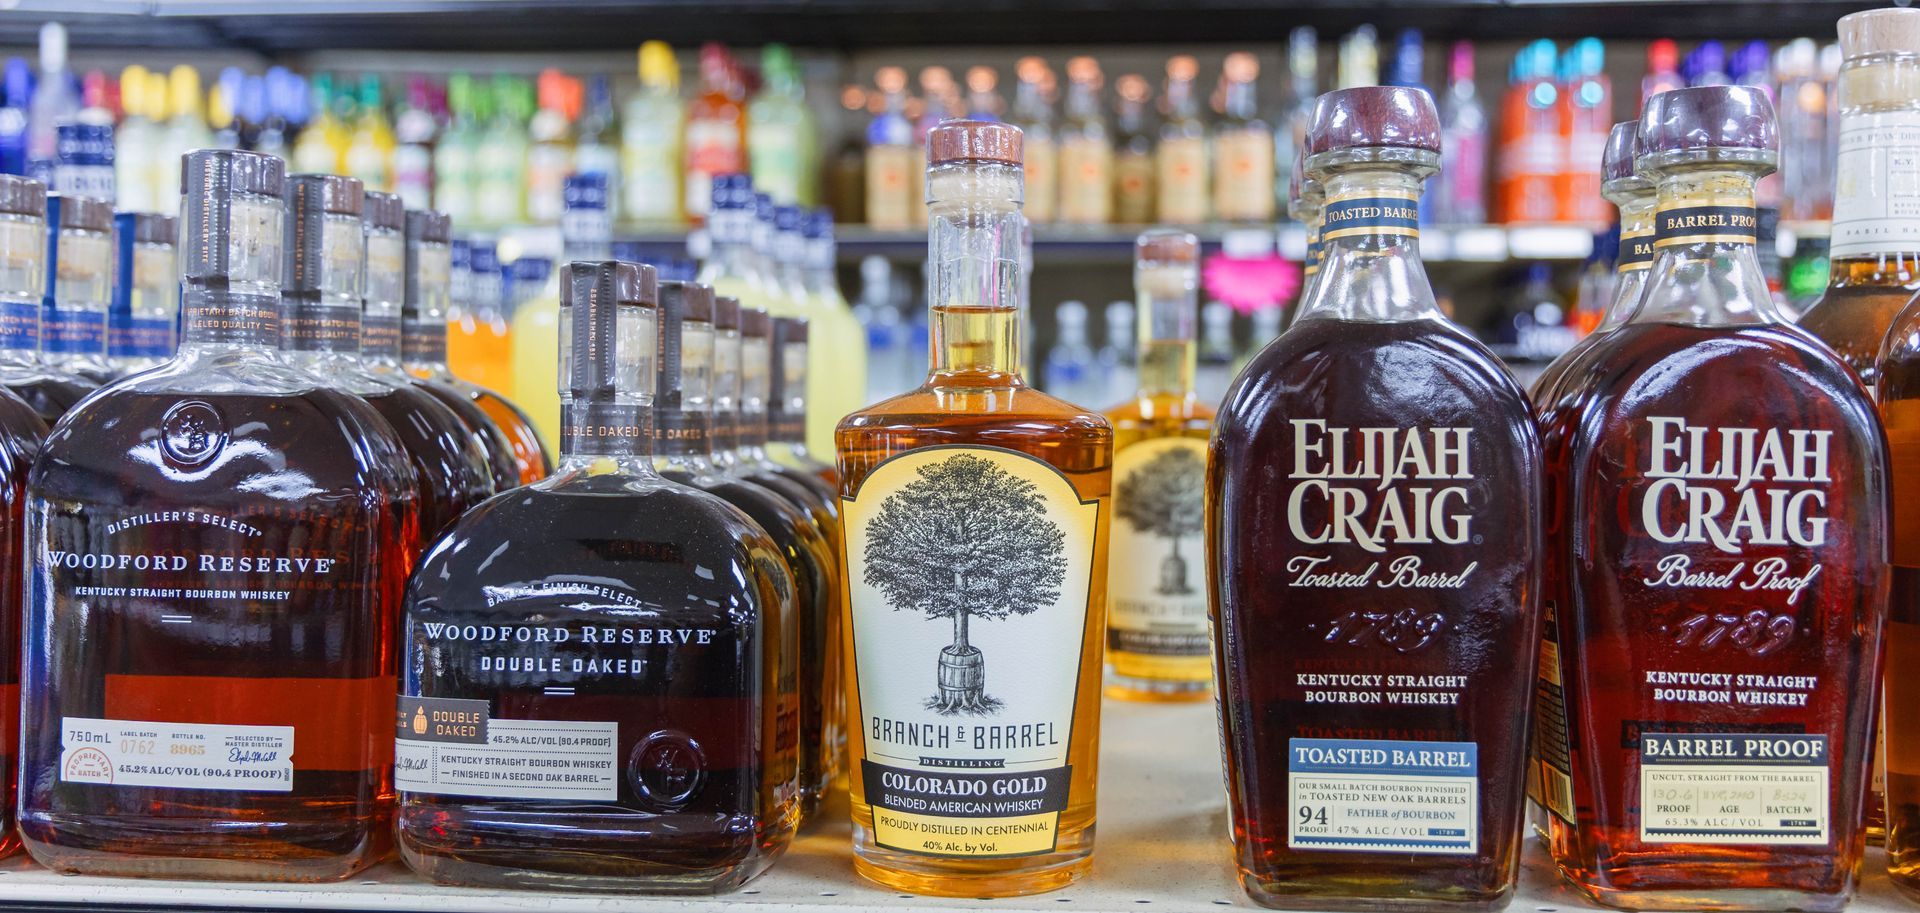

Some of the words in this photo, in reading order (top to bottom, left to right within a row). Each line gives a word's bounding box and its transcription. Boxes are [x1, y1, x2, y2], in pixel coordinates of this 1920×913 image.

[1329, 207, 1380, 223] TOASTED
[1667, 215, 1727, 230] BARREL
[222, 320, 261, 330] QUALITY
[599, 426, 639, 437] OAKED
[1288, 418, 1475, 492] ELIJAH
[1644, 416, 1834, 493] ELIJAH
[1287, 479, 1473, 553] CRAIG
[1642, 477, 1828, 553] CRAIG
[202, 513, 257, 537] SELECT
[47, 550, 188, 571] WOODFORD
[199, 554, 331, 574] RESERVE
[1286, 555, 1379, 588] Toasted
[1376, 555, 1478, 589] Barrel
[1643, 554, 1745, 589] Barrel
[1740, 557, 1822, 605] Proof
[75, 586, 127, 597] KENTUCKY
[130, 588, 182, 598] STRAIGHT
[185, 589, 237, 599] BOURBON
[240, 590, 290, 600] WHISKEY
[542, 582, 589, 593] FINISH
[594, 586, 642, 608] SELECT
[423, 622, 570, 641] WOODFORD
[581, 625, 713, 645] RESERVE
[1675, 608, 1796, 656] 1789
[481, 656, 561, 673] DOUBLE
[1296, 673, 1383, 687] KENTUCKY
[1387, 675, 1468, 688] STRAIGHT
[1645, 671, 1733, 686] KENTUCKY
[1736, 674, 1817, 689] STRAIGHT
[1305, 691, 1382, 703] BOURBON
[1386, 692, 1459, 704] WHISKEY
[1653, 688, 1731, 703] BOURBON
[1735, 691, 1808, 705] WHISKEY
[433, 710, 480, 724] DOUBLE
[69, 730, 112, 744] 750mL
[436, 724, 476, 737] OAKED
[872, 716, 950, 749] BRANCH
[955, 725, 967, 742] &
[974, 722, 1059, 750] BARREL
[120, 739, 155, 755] 0762
[492, 735, 519, 744] 45.2%
[520, 736, 557, 746] ALC/VOL
[1644, 739, 1738, 757] BARREL
[1744, 739, 1823, 757] PROOF
[170, 743, 206, 756] 8965
[69, 752, 110, 778] PROPRIETARY
[441, 755, 483, 765] KENTUCKY
[485, 757, 527, 767] STRAIGHT
[529, 759, 570, 768] BOURBON
[572, 760, 612, 769] WHISKEY
[922, 758, 1001, 767] DISTILLING
[1295, 747, 1387, 765] TOASTED
[1392, 750, 1471, 768] BARREL
[77, 769, 102, 778] BATCH
[118, 764, 148, 774] 45.2%
[149, 765, 201, 776] ALC/VOL
[202, 768, 232, 777] (90.4
[234, 768, 282, 779] PROOF)
[452, 769, 490, 780] FINISHED
[491, 772, 500, 780] IN
[502, 772, 508, 780] A
[509, 772, 543, 782] SECOND
[545, 774, 563, 782] OAK
[564, 774, 599, 783] BARREL
[1688, 774, 1732, 782] STRAIGHT
[1734, 774, 1759, 782] FROM
[1762, 774, 1780, 782] THE
[1781, 775, 1816, 783] BARREL
[881, 771, 988, 796] COLORADO
[992, 776, 1047, 796] GOLD
[1319, 783, 1348, 791] SMALL
[1380, 785, 1423, 793] BOURBON
[1425, 786, 1466, 794] FINISHED
[884, 793, 927, 810] BLENDED
[929, 800, 991, 814] AMERICAN
[993, 798, 1044, 813] WHISKEY
[1299, 792, 1307, 800] in
[1309, 792, 1360, 801] TOASTED
[1363, 793, 1388, 802] NEW
[1390, 794, 1415, 803] OAK
[1417, 795, 1467, 804] BARRELS
[1299, 805, 1329, 826] 94
[1347, 808, 1389, 818] FATHER
[1390, 809, 1402, 821] of
[1402, 810, 1456, 820] BOURBON
[1656, 804, 1691, 813] PROOF
[1719, 805, 1740, 813] AGE
[1766, 805, 1801, 814] BATCH
[880, 815, 919, 832] PROUDLY
[921, 824, 968, 836] DISTILLED
[971, 826, 983, 835] IN
[986, 821, 1048, 836] CENTENNIAL
[1299, 825, 1329, 834] PROOF
[1337, 825, 1360, 834] 47%
[1665, 818, 1698, 826] 65.3%
[922, 841, 943, 851] 40%
[945, 842, 963, 852] Alc.
[965, 842, 977, 854] by
[979, 842, 998, 852] Vol.
